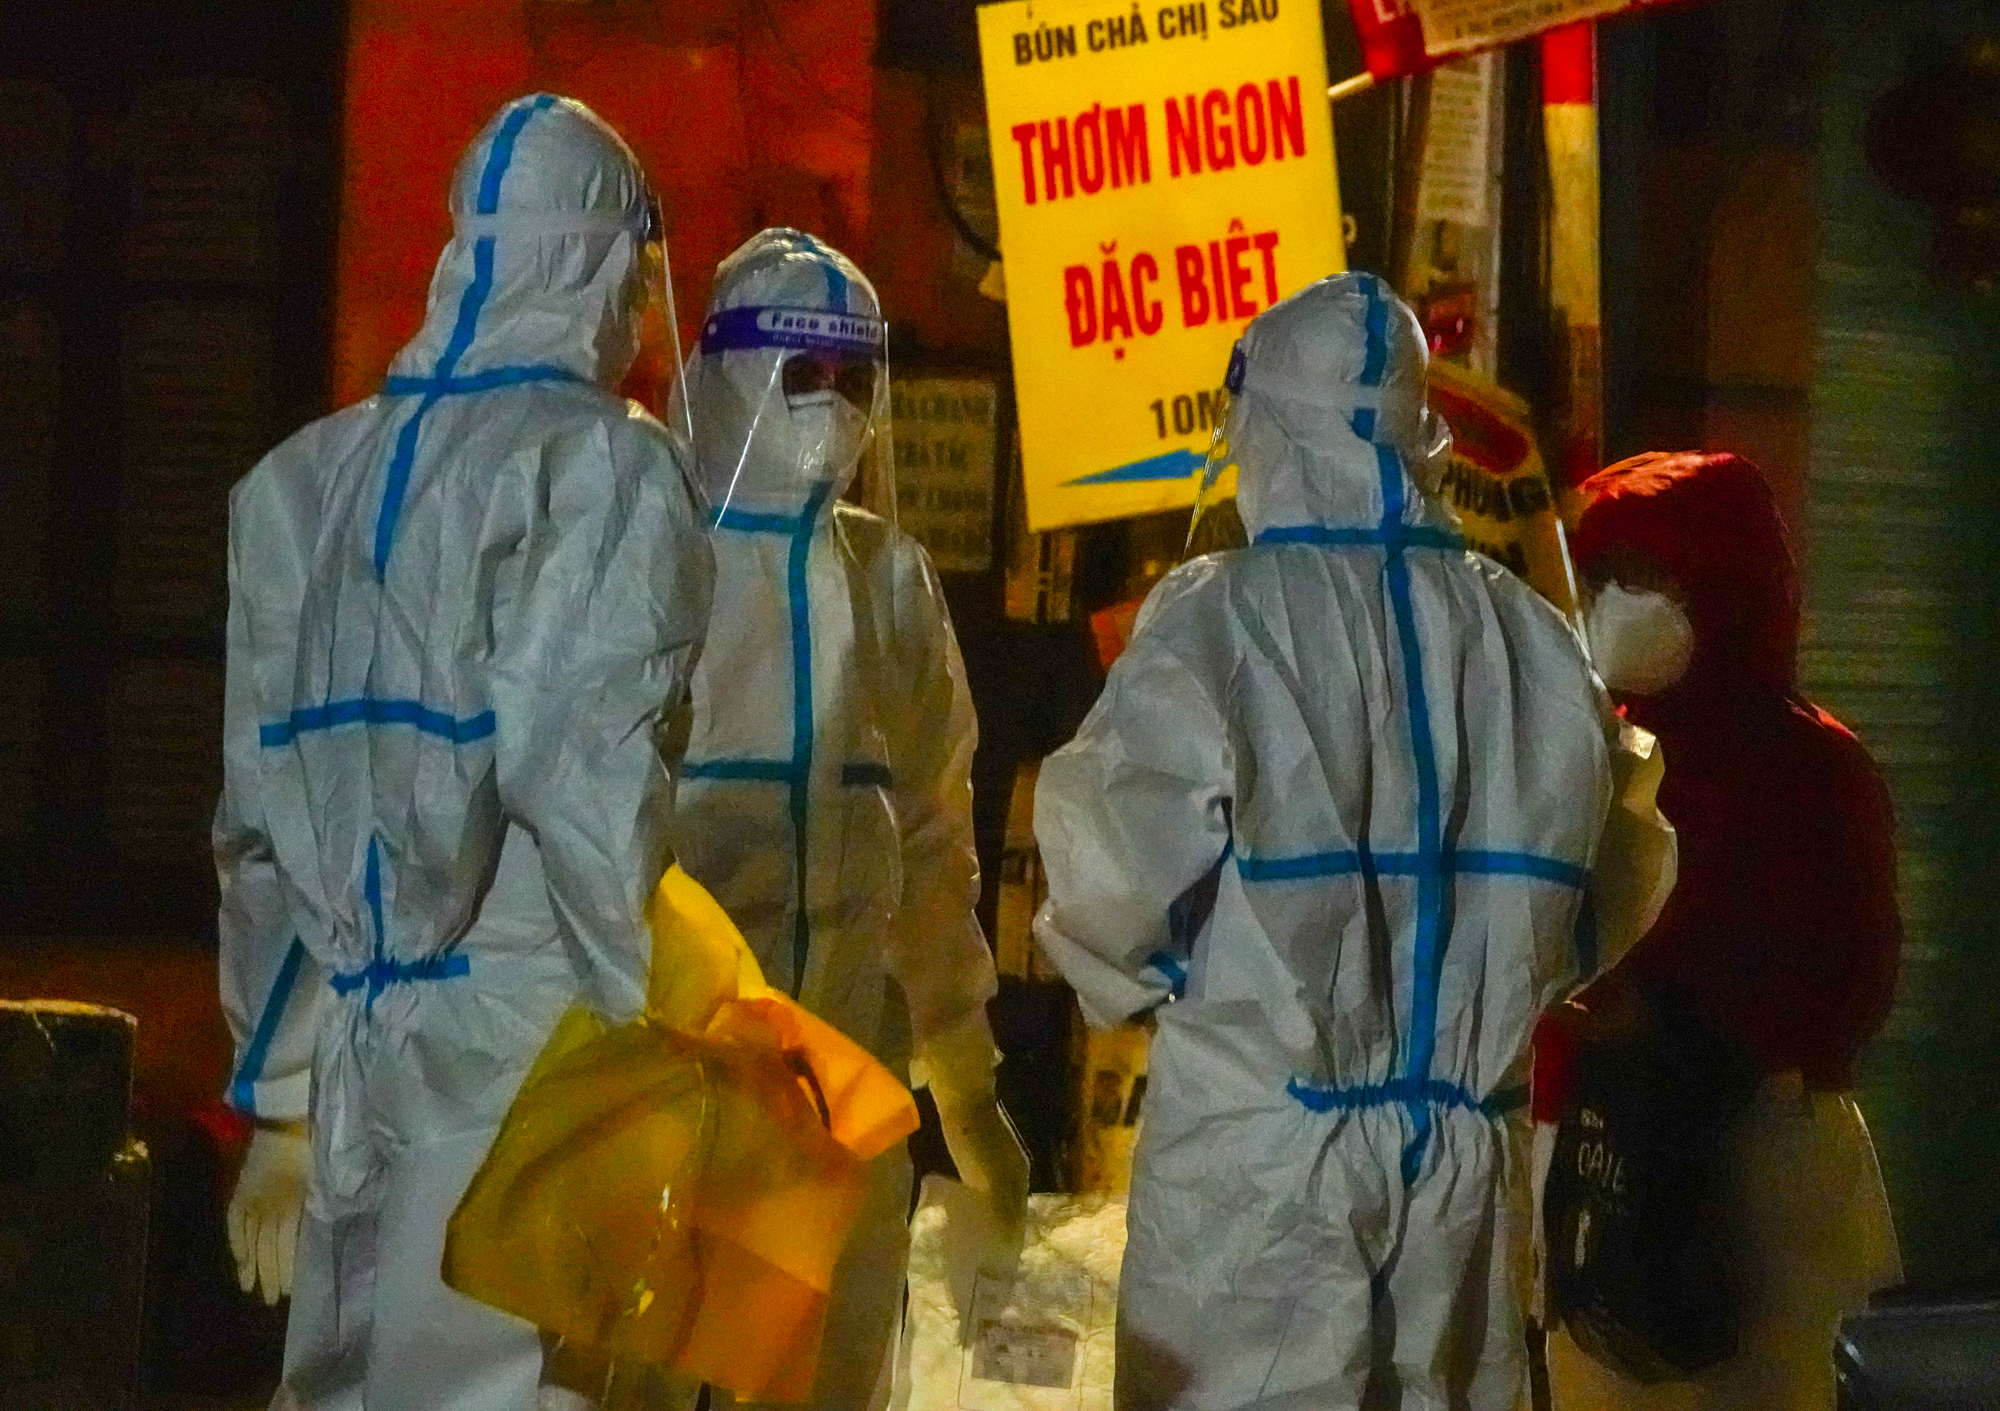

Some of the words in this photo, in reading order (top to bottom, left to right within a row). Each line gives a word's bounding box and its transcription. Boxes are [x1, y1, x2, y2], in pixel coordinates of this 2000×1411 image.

[1013, 21, 1077, 66] BÚN
[1087, 2, 1149, 52] CHẢ
[1157, 3, 1209, 40] CHỊ
[1011, 102, 1151, 206] THƠM
[1164, 75, 1306, 179] NGON
[1063, 240, 1164, 361] ĐẶC
